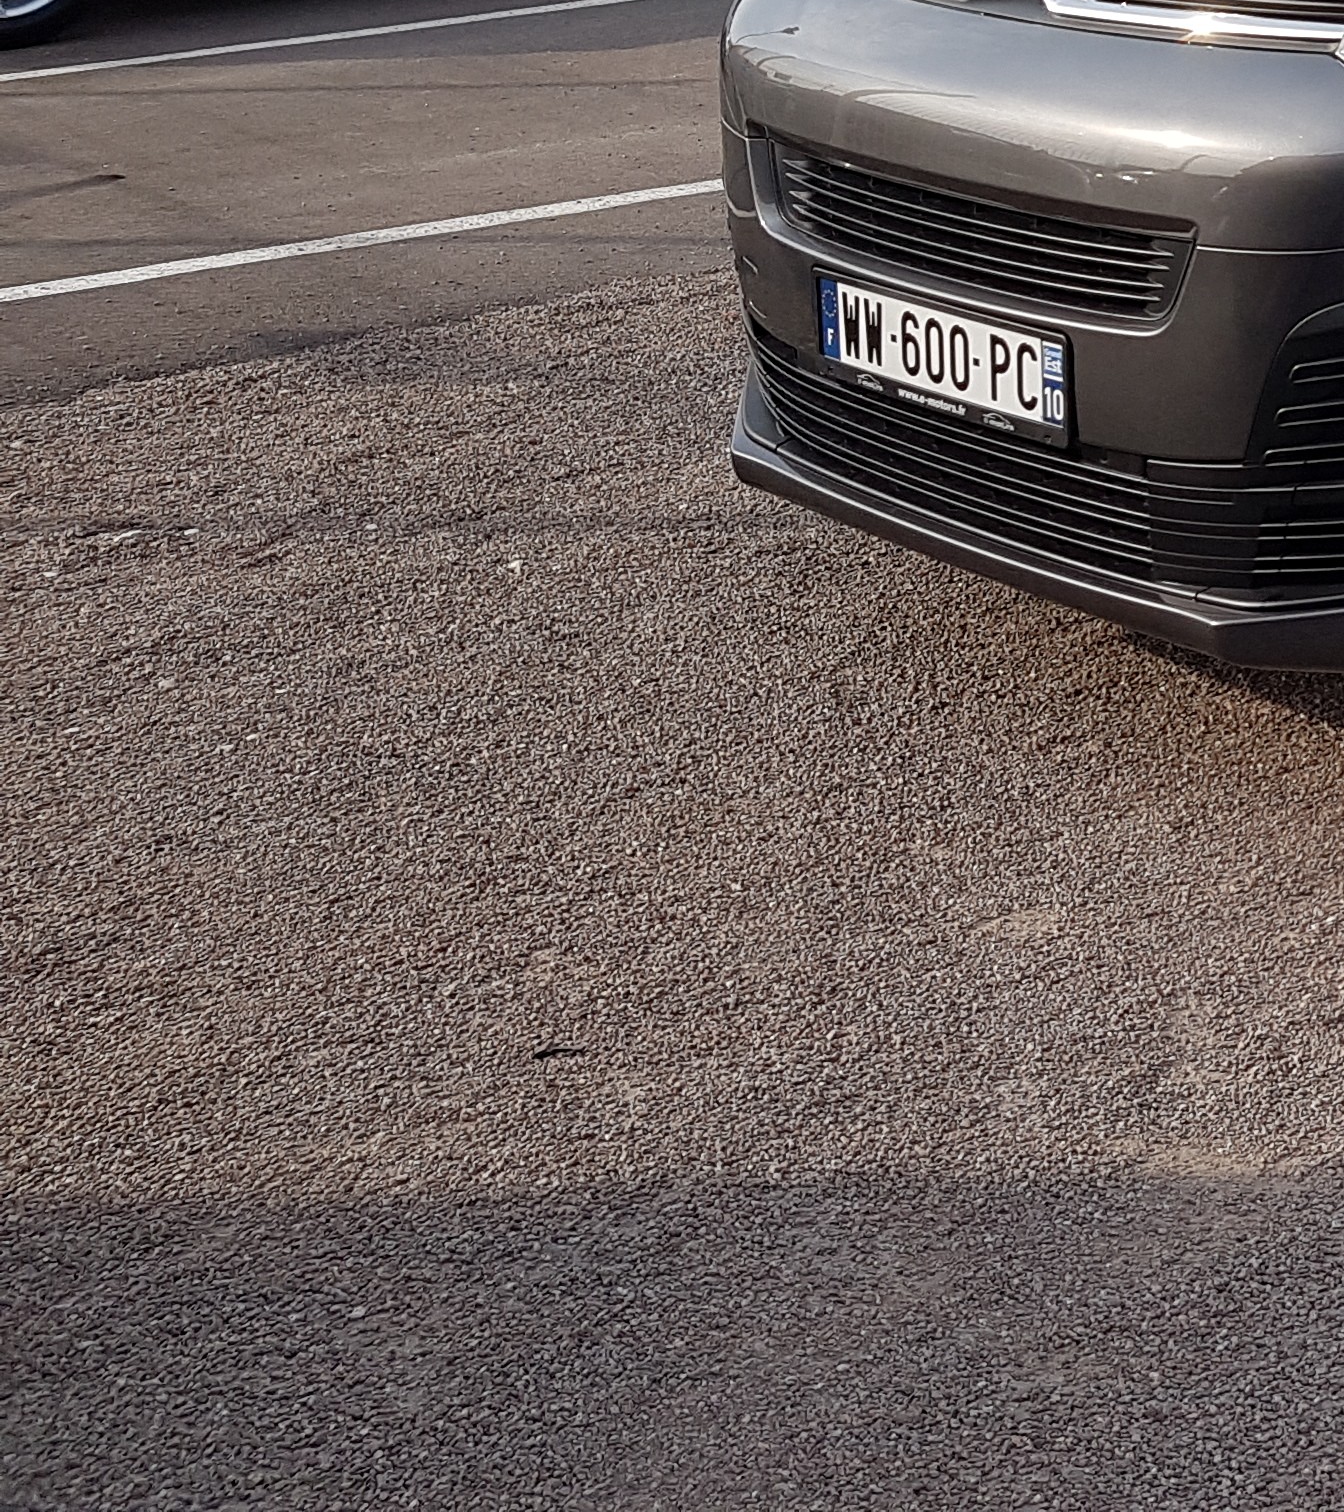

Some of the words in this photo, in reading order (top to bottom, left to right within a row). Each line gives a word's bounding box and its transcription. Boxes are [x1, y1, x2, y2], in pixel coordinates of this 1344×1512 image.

[827, 327, 835, 346] F
[841, 291, 1039, 411] WW-600-PC
[1044, 386, 1065, 421] 10
